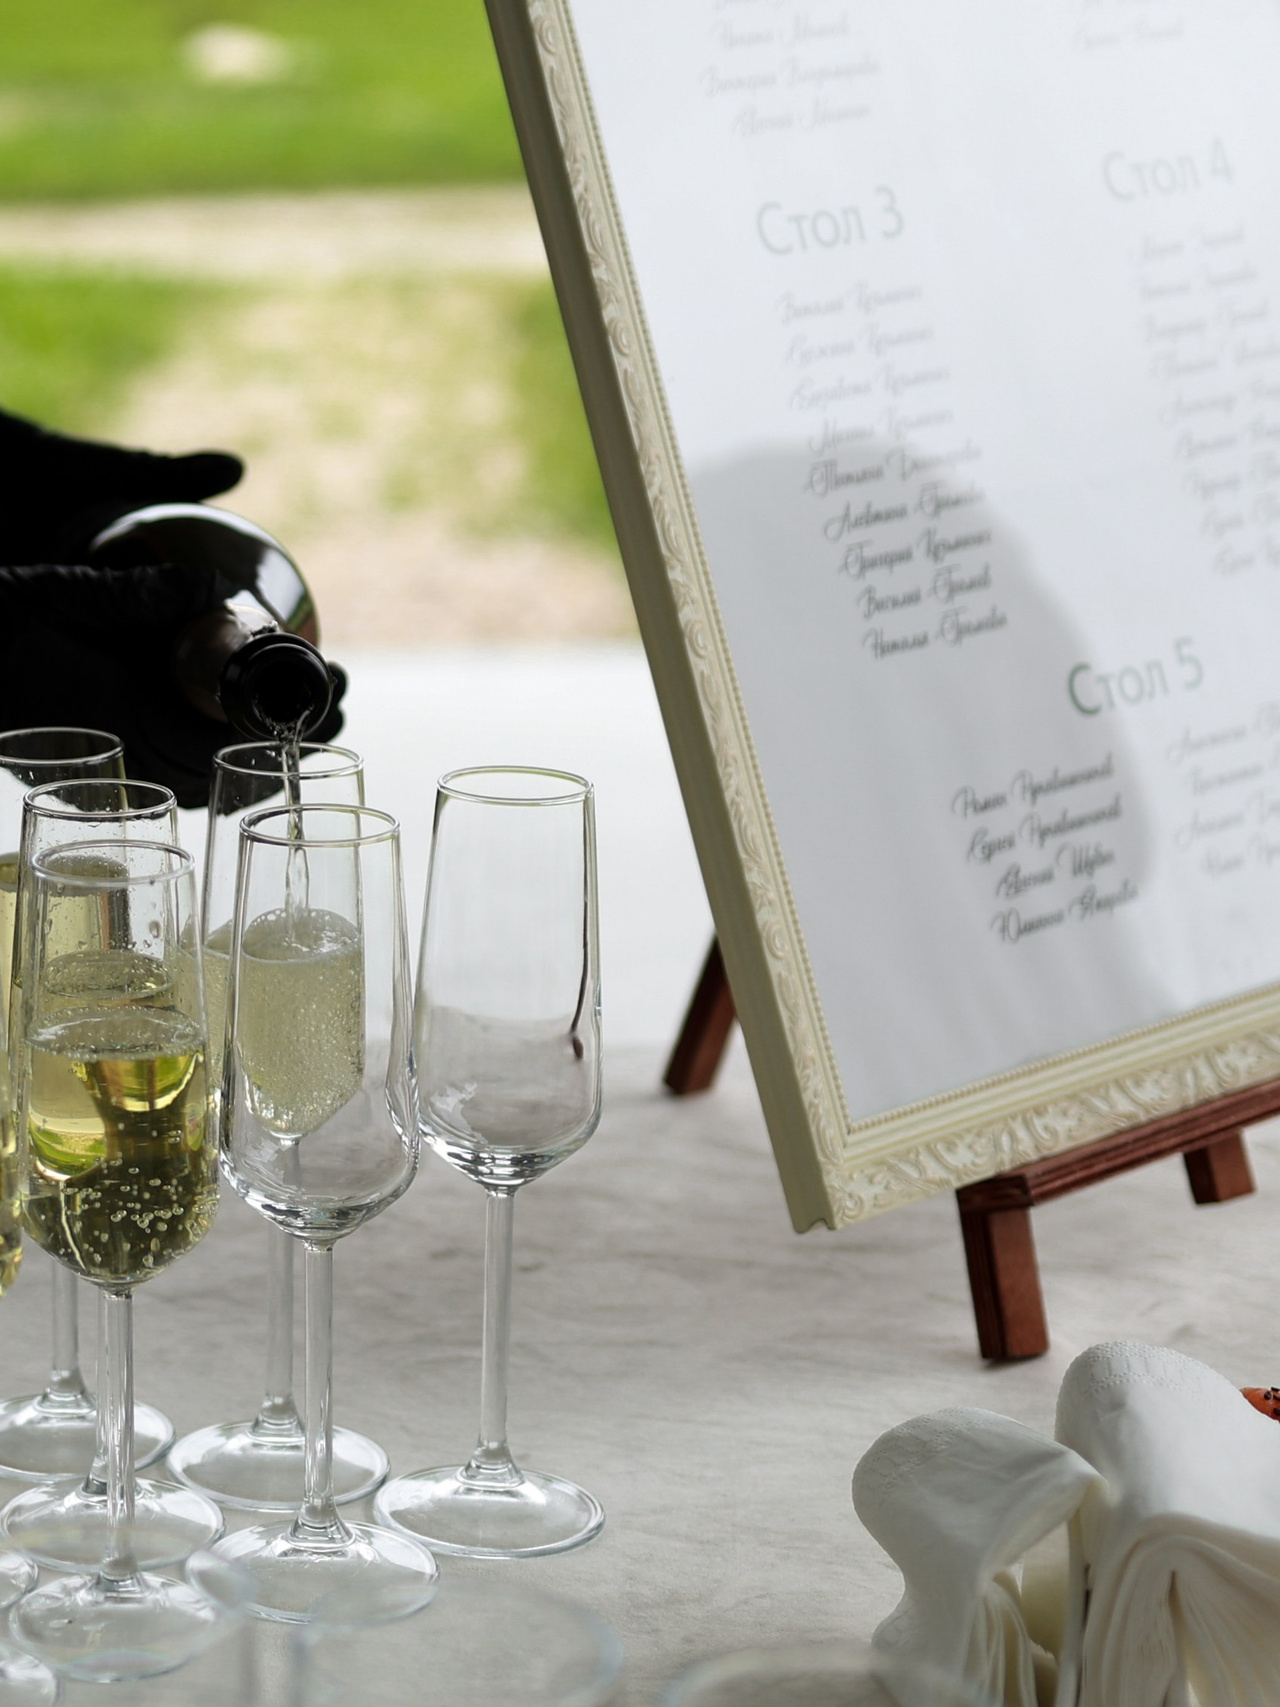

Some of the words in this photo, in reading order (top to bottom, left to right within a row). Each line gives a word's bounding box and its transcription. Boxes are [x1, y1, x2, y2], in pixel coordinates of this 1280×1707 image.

[1101, 149, 1201, 202] Стол
[1210, 136, 1234, 184] 4
[755, 199, 867, 256] Стол
[874, 184, 905, 240] 3
[823, 501, 908, 542] Алевтина
[836, 539, 913, 580] Григорий
[856, 584, 922, 620] Василий
[1067, 659, 1169, 716] Стол
[1173, 637, 1204, 691] 5
